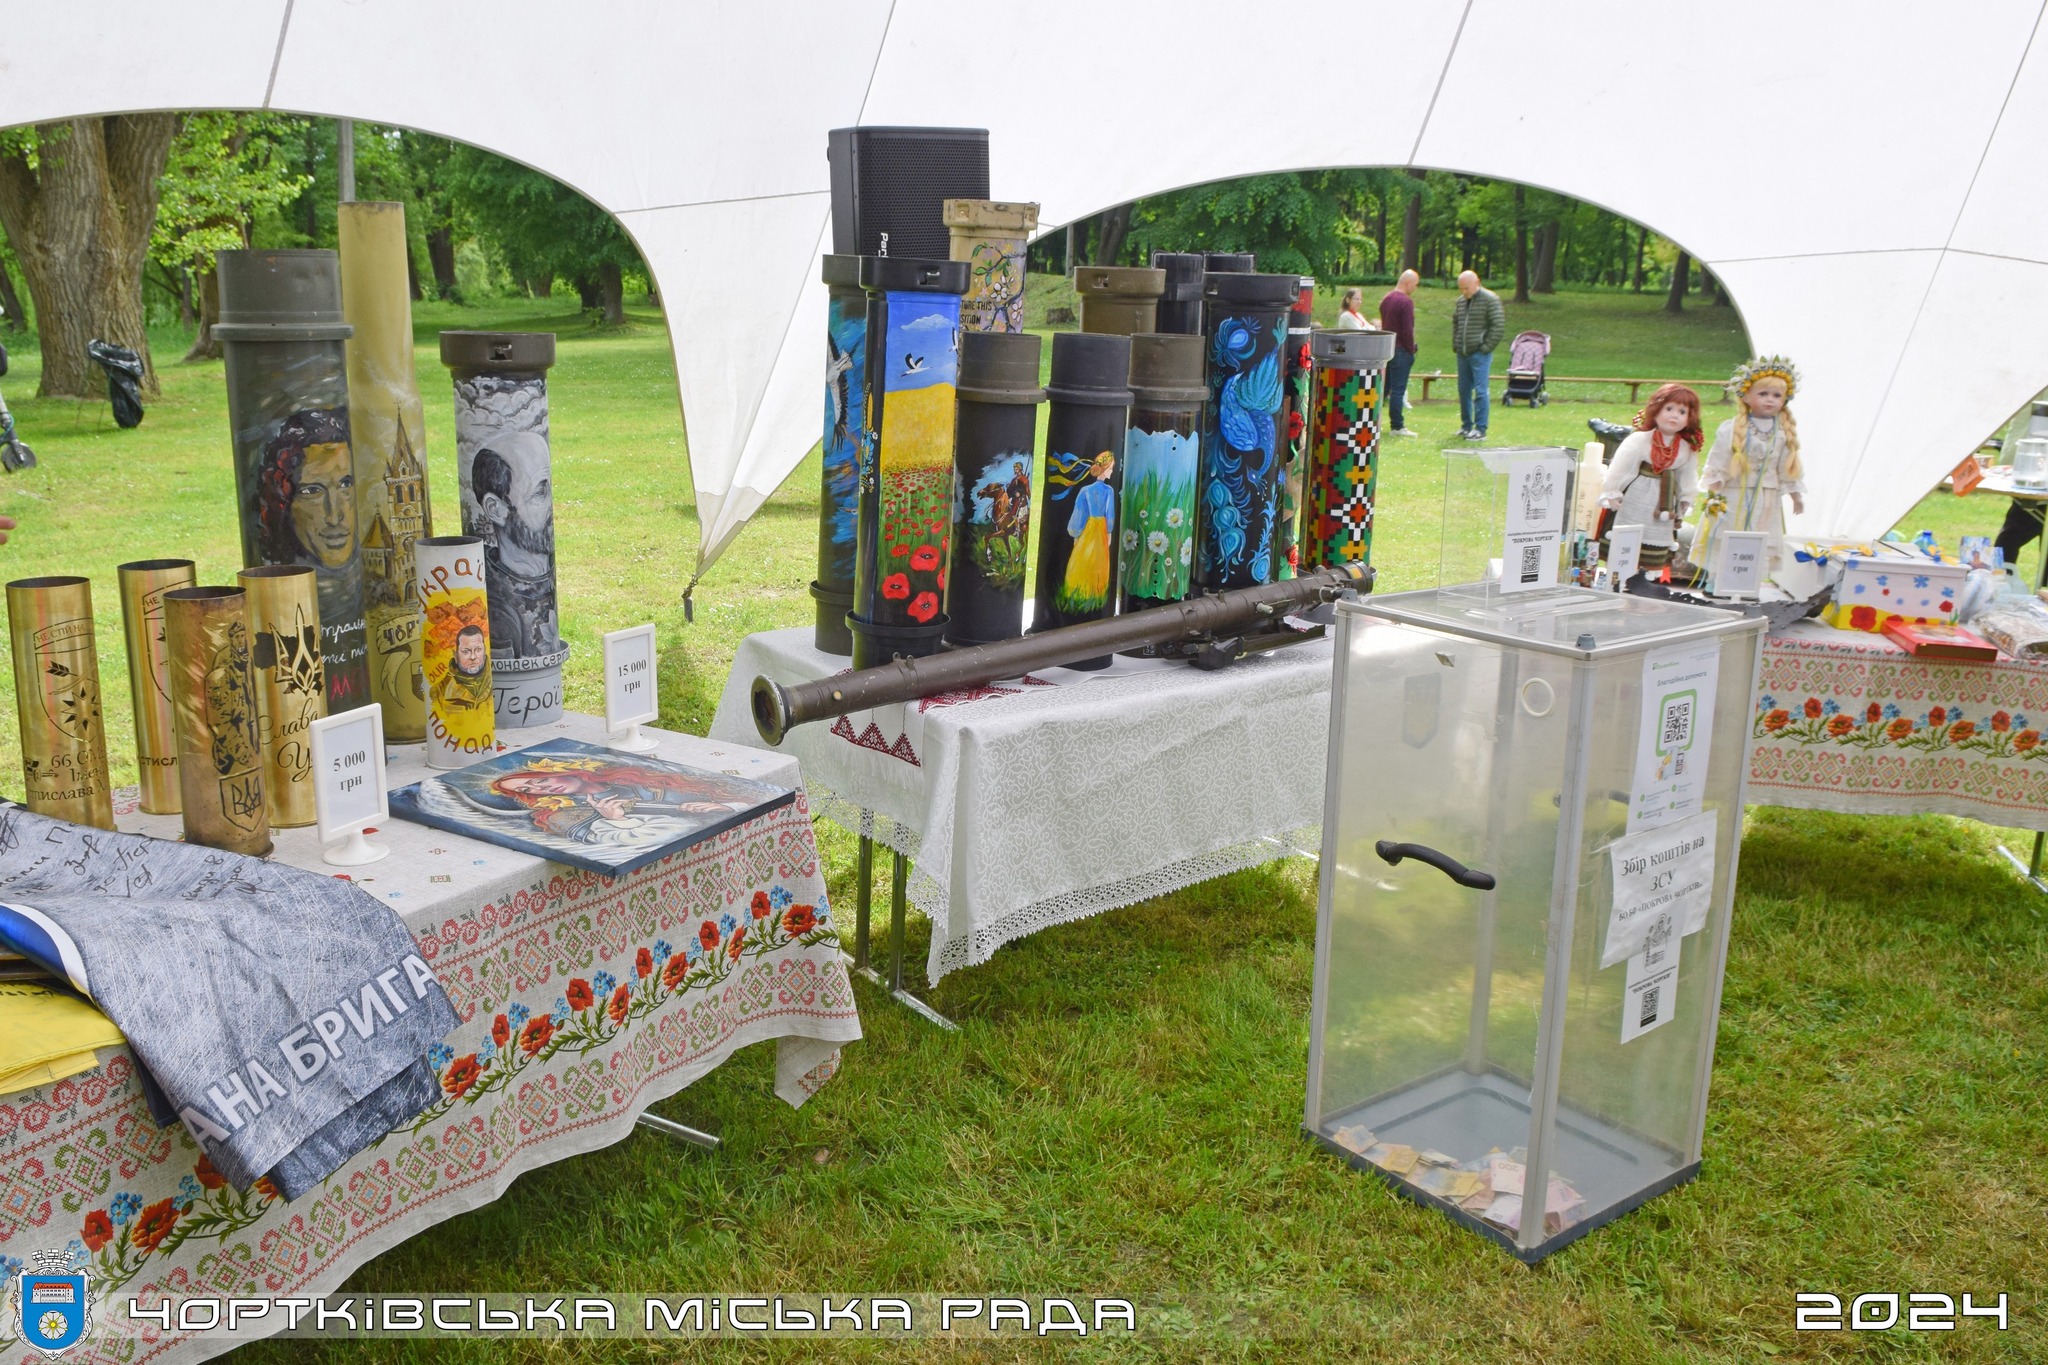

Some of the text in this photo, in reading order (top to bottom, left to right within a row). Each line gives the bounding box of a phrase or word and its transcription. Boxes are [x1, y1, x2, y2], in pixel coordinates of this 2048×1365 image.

[977, 300, 993, 311] THIS
[1739, 554, 1754, 562] 000
[1733, 566, 1748, 574] грн
[618, 659, 647, 677] 15 000
[624, 680, 641, 694] грн
[51, 753, 72, 769] 66
[333, 750, 366, 772] 5 000
[340, 775, 363, 792] грн
[1621, 835, 1705, 877] Збір коштів на
[1650, 868, 1676, 892] ЗСУ
